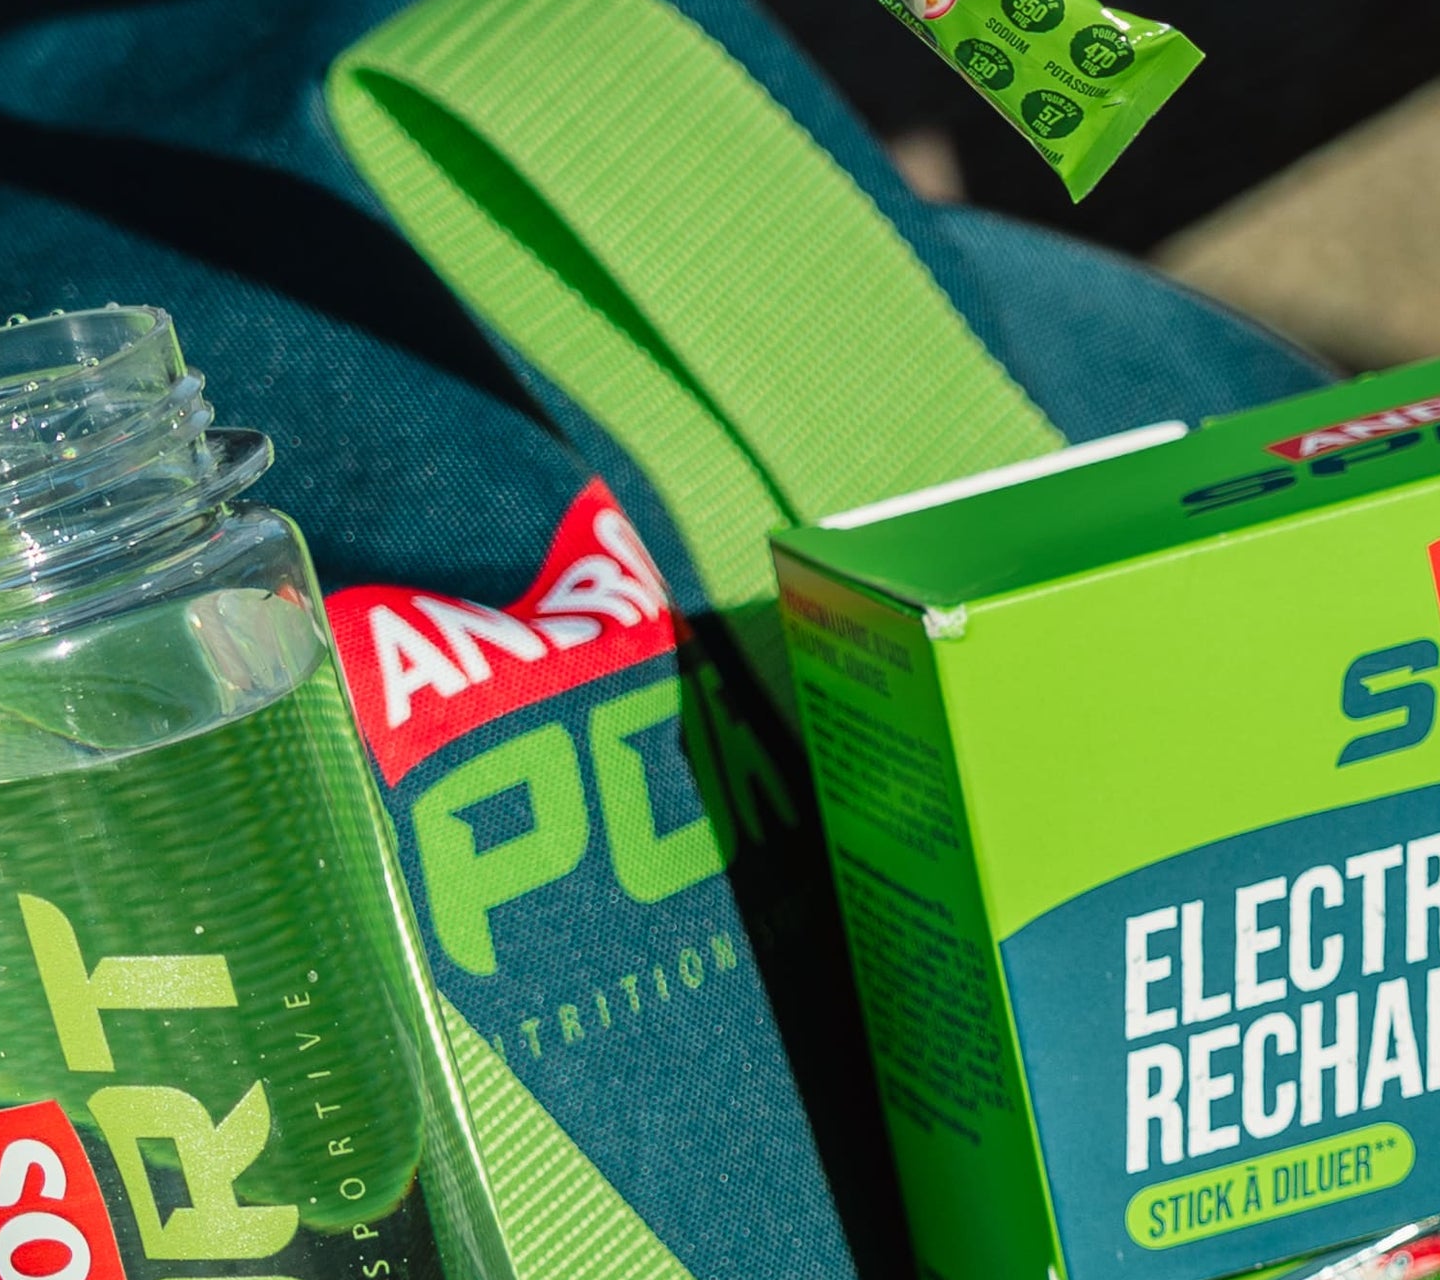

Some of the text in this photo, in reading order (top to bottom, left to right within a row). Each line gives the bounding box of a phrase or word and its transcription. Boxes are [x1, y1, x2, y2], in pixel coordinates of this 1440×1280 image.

[1011, 11, 1033, 29] mg
[985, 17, 1031, 55] SODIUM
[1091, 27, 1117, 41] POUR
[968, 52, 999, 80] 130
[1083, 42, 1118, 69] 470
[1044, 60, 1111, 99] POTASSIUM
[1080, 60, 1102, 76] mg
[1040, 92, 1065, 106] POUR
[1031, 119, 1052, 136] mg
[1039, 105, 1065, 126] 57
[284, 991, 391, 1280] SPORTIVE
[1149, 1180, 1236, 1240] STICK
[1243, 1166, 1262, 1214] À
